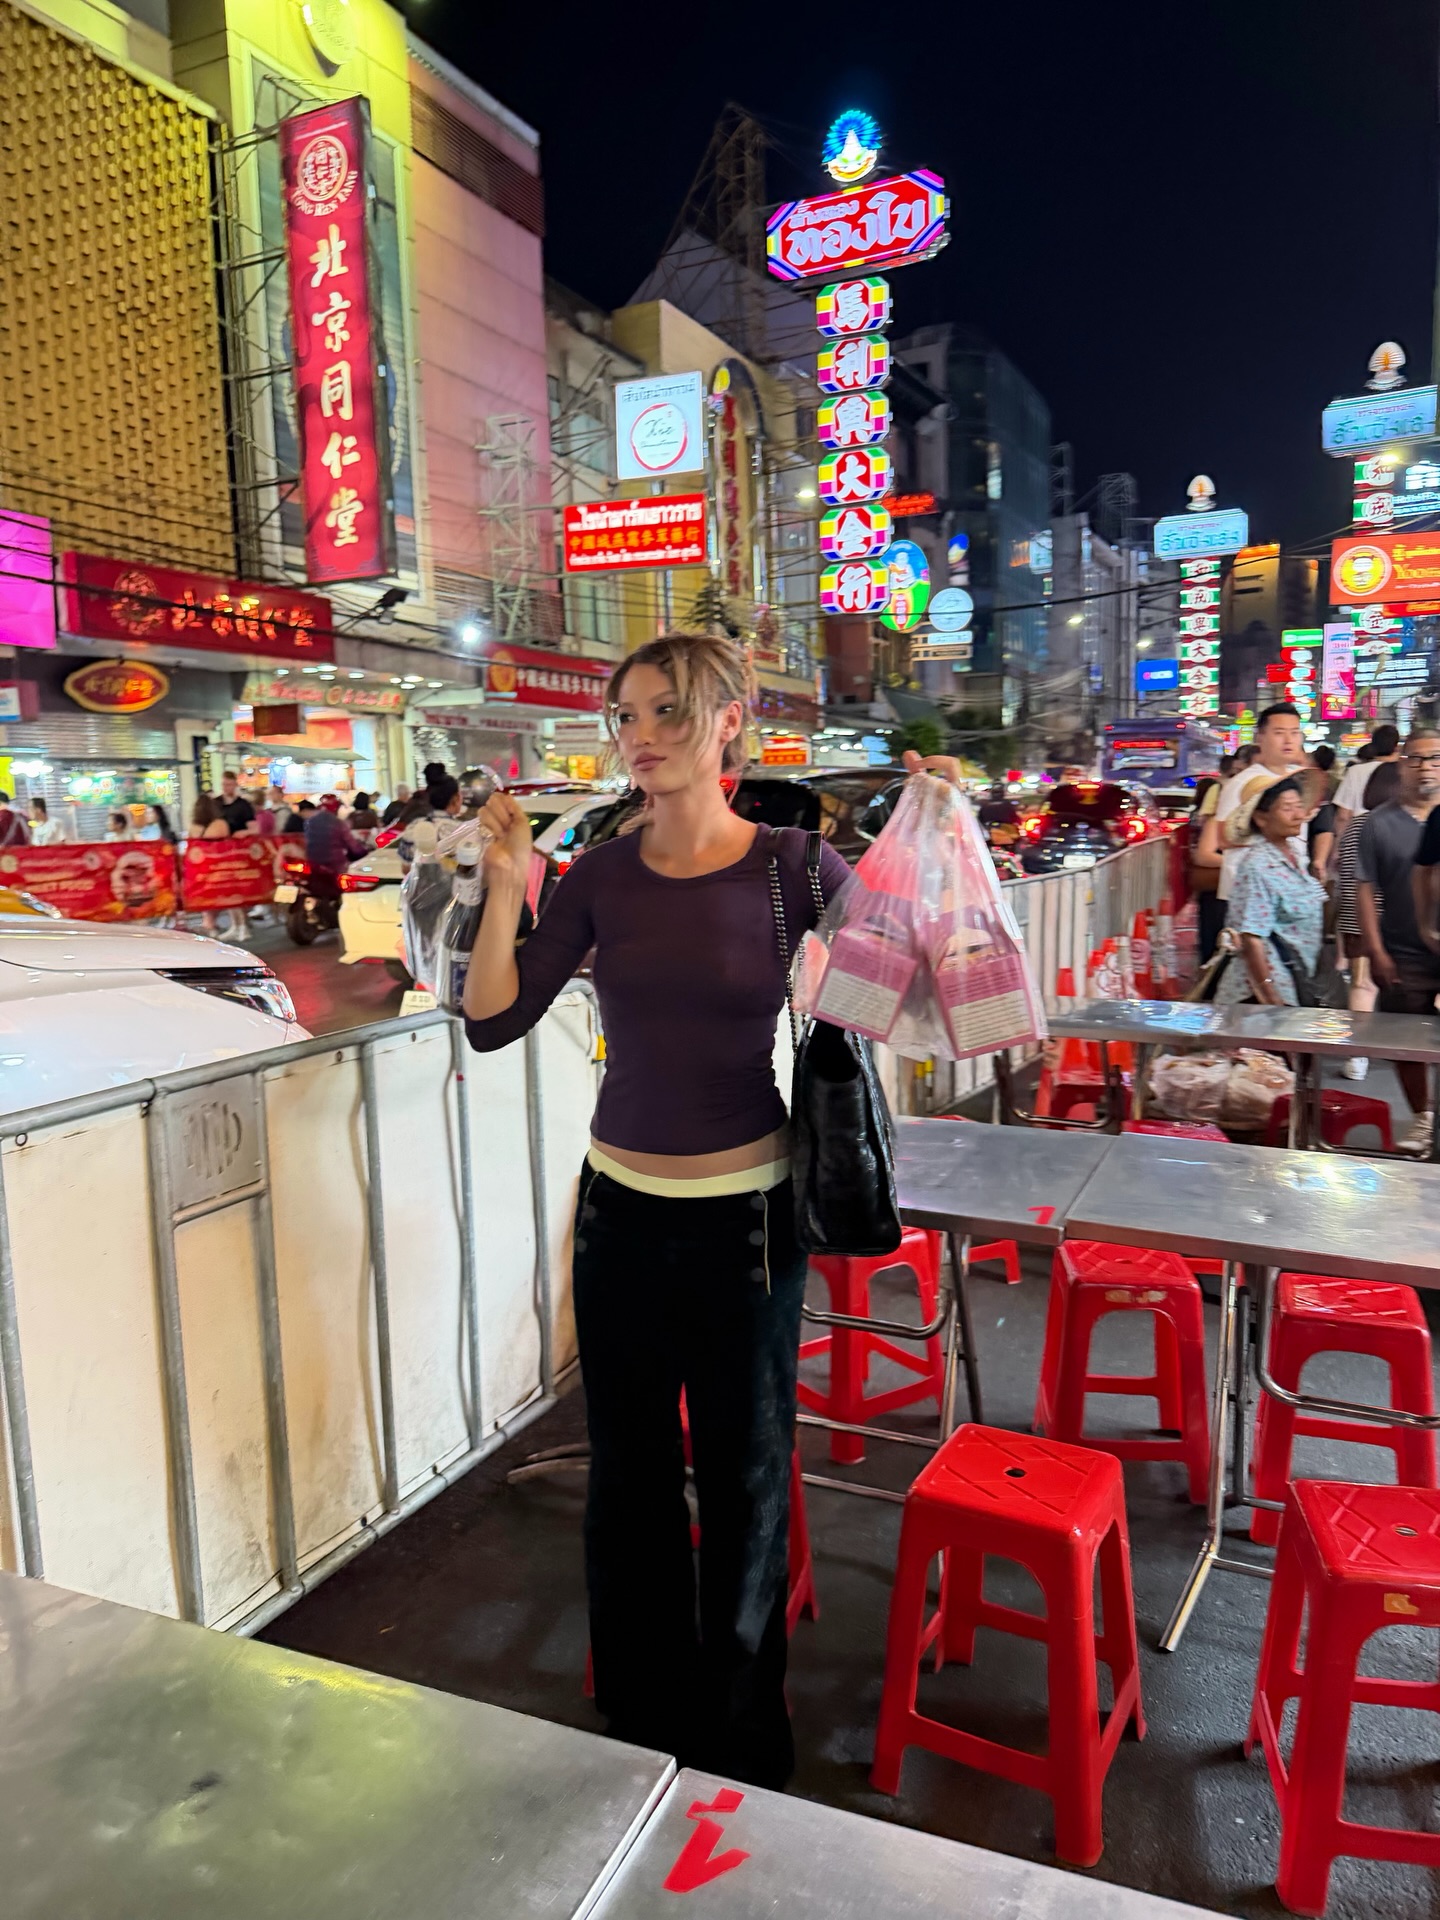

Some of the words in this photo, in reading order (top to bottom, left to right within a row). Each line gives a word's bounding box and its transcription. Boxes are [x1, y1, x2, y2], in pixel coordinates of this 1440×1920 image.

[308, 223, 364, 548] 北京同仁堂
